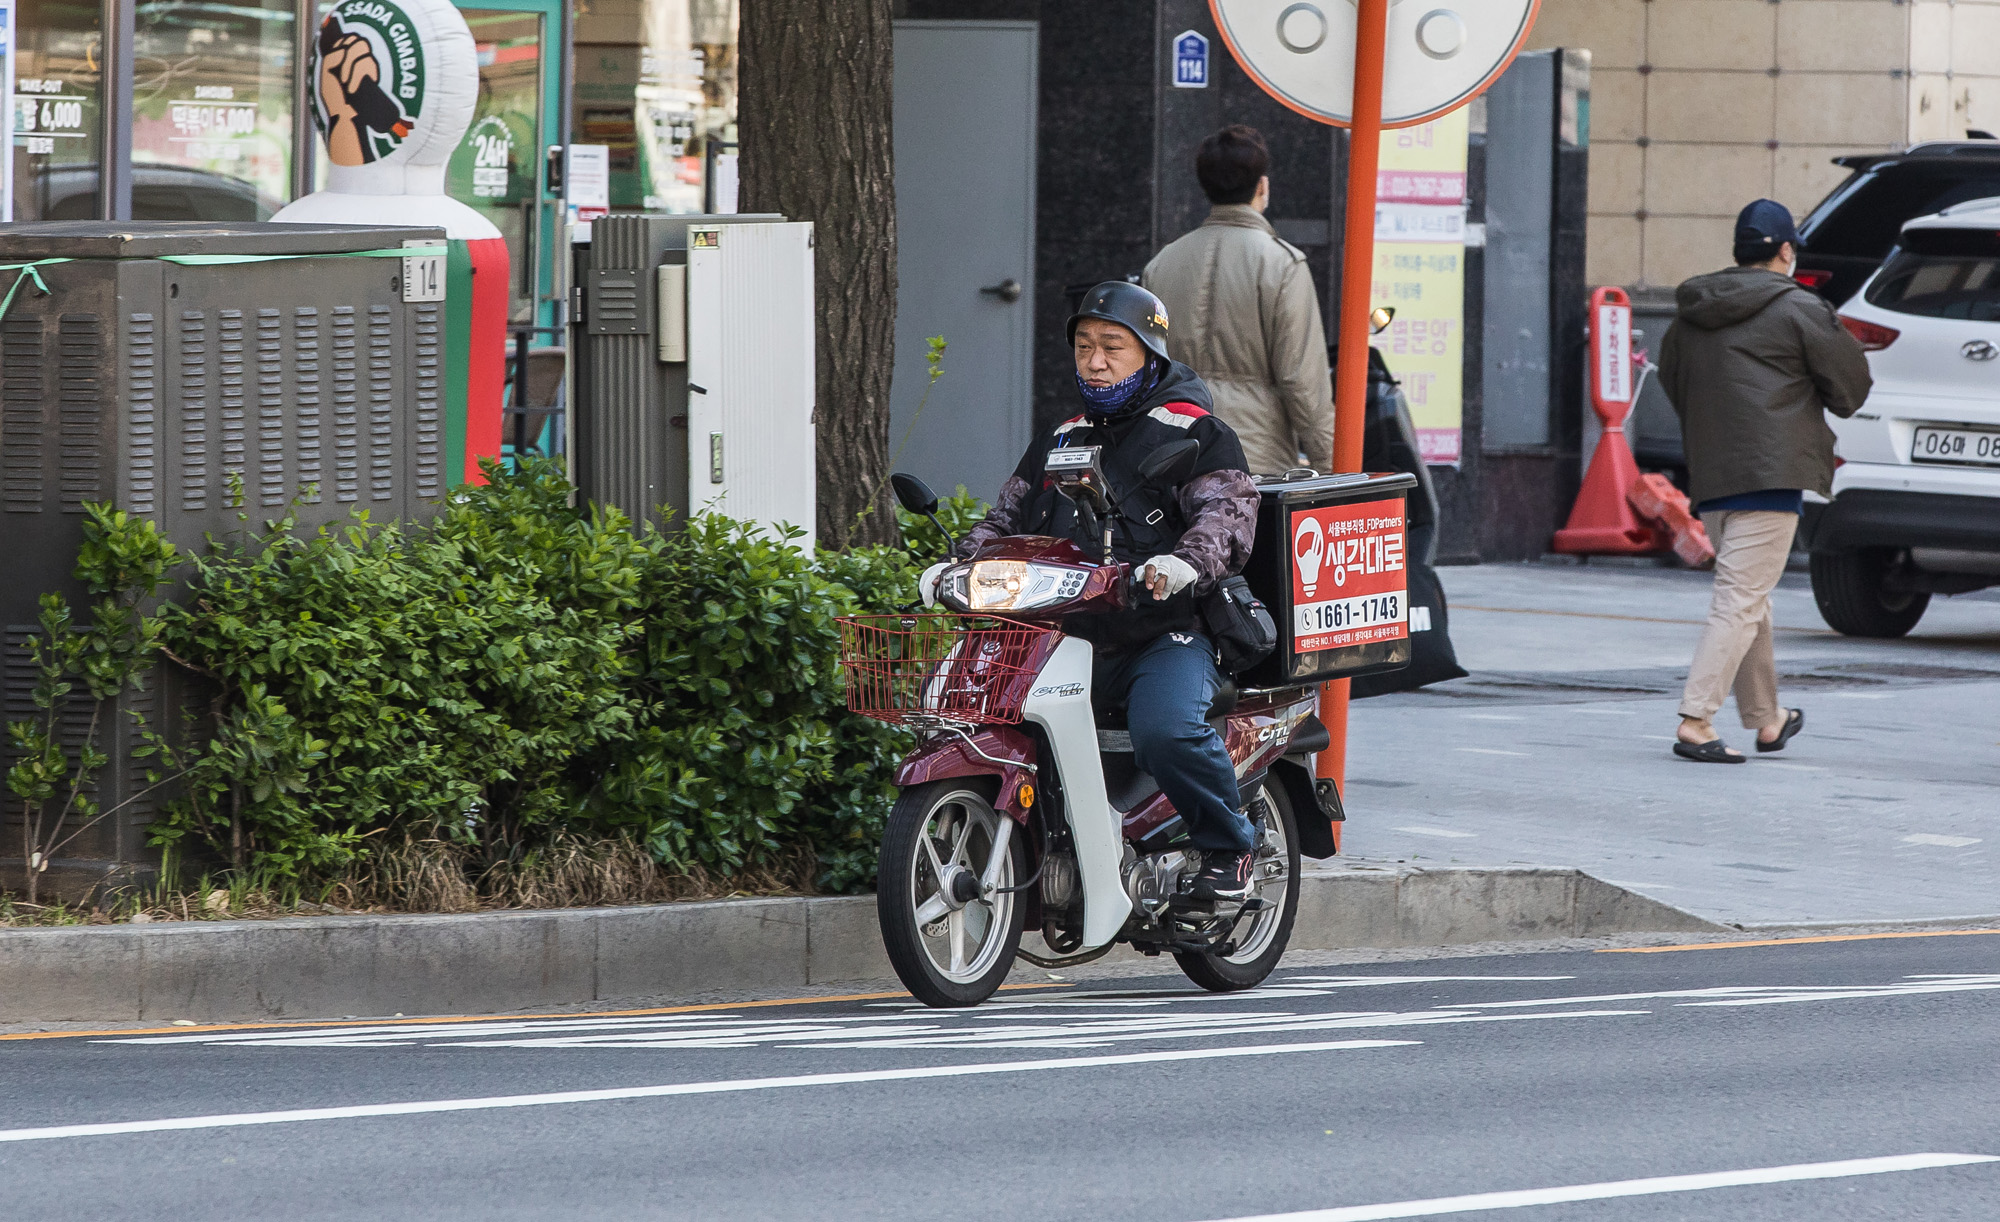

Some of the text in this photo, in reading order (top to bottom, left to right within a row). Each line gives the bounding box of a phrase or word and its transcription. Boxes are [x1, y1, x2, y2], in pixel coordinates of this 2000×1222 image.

[344, 1, 418, 99] SSADA GIMBAB
[1181, 59, 1203, 80] 114
[41, 102, 81, 131] 6,000
[474, 134, 508, 167] 24H
[420, 260, 437, 296] 14
[1325, 532, 1404, 587] 생각대로
[1315, 595, 1398, 629] 1661-1743
[1301, 637, 1320, 649] 대한민국
[1321, 636, 1332, 646] NO.1
[1355, 629, 1373, 642] 생각대로
